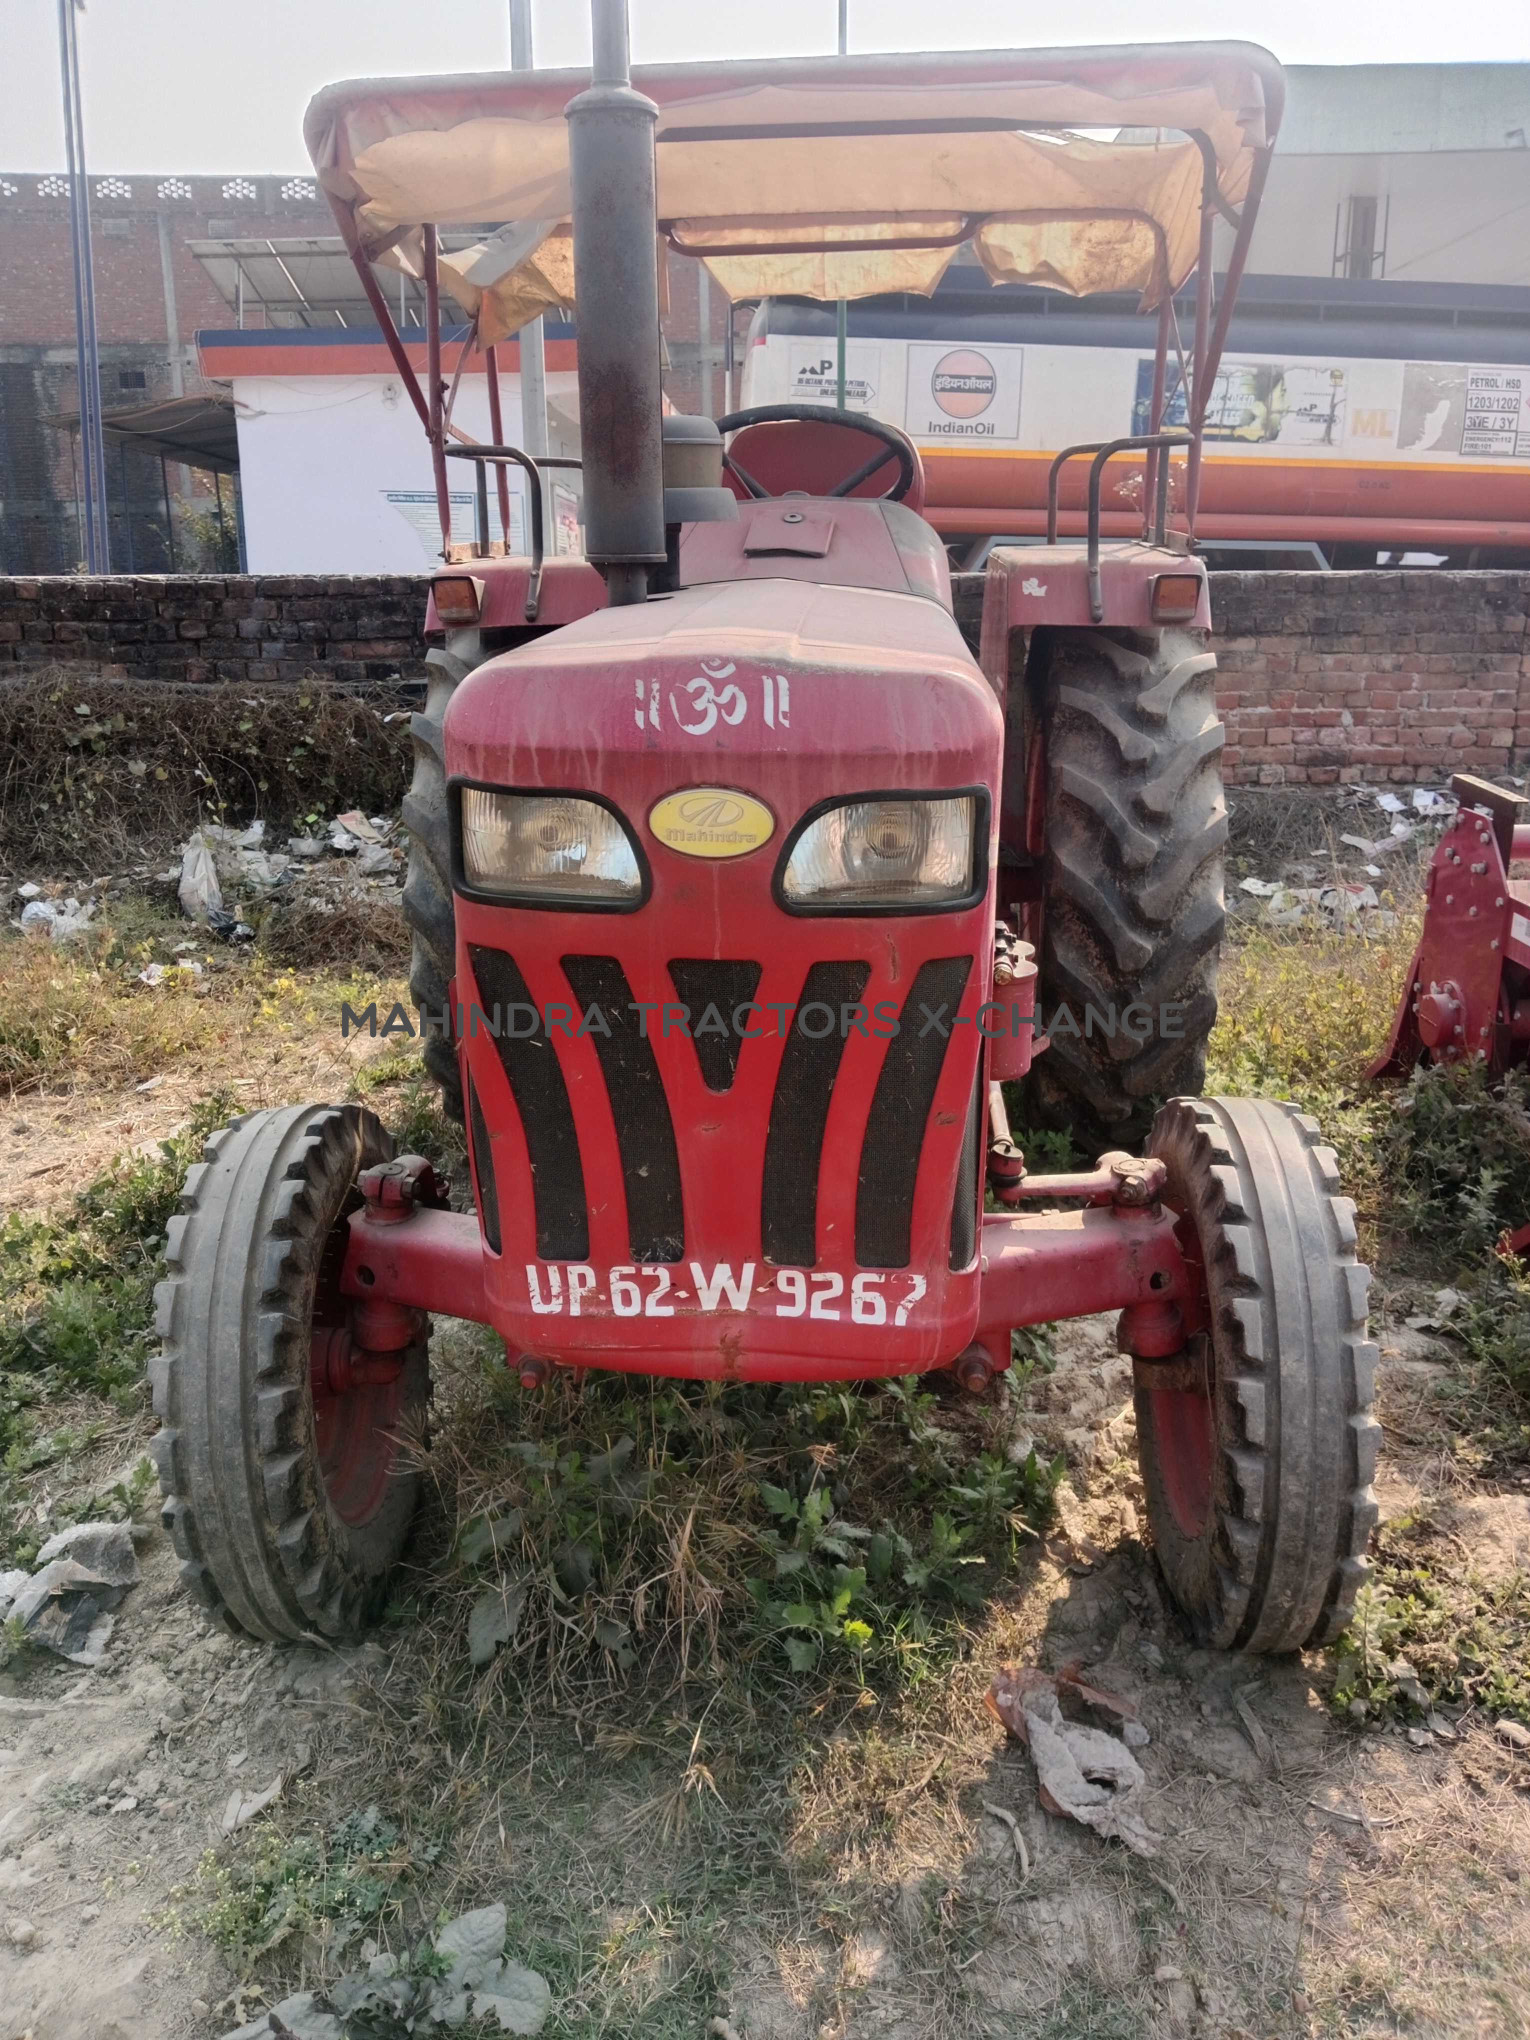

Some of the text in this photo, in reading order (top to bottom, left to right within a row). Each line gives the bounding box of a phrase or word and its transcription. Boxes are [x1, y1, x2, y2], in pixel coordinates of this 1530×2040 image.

[1470, 377, 1499, 388] PETROL
[1505, 379, 1521, 389] HSD
[1468, 396, 1519, 410] 1203/1202
[928, 421, 995, 435] IndianOil
[1499, 417, 1515, 429] 3Y
[666, 828, 758, 844] Mahindra
